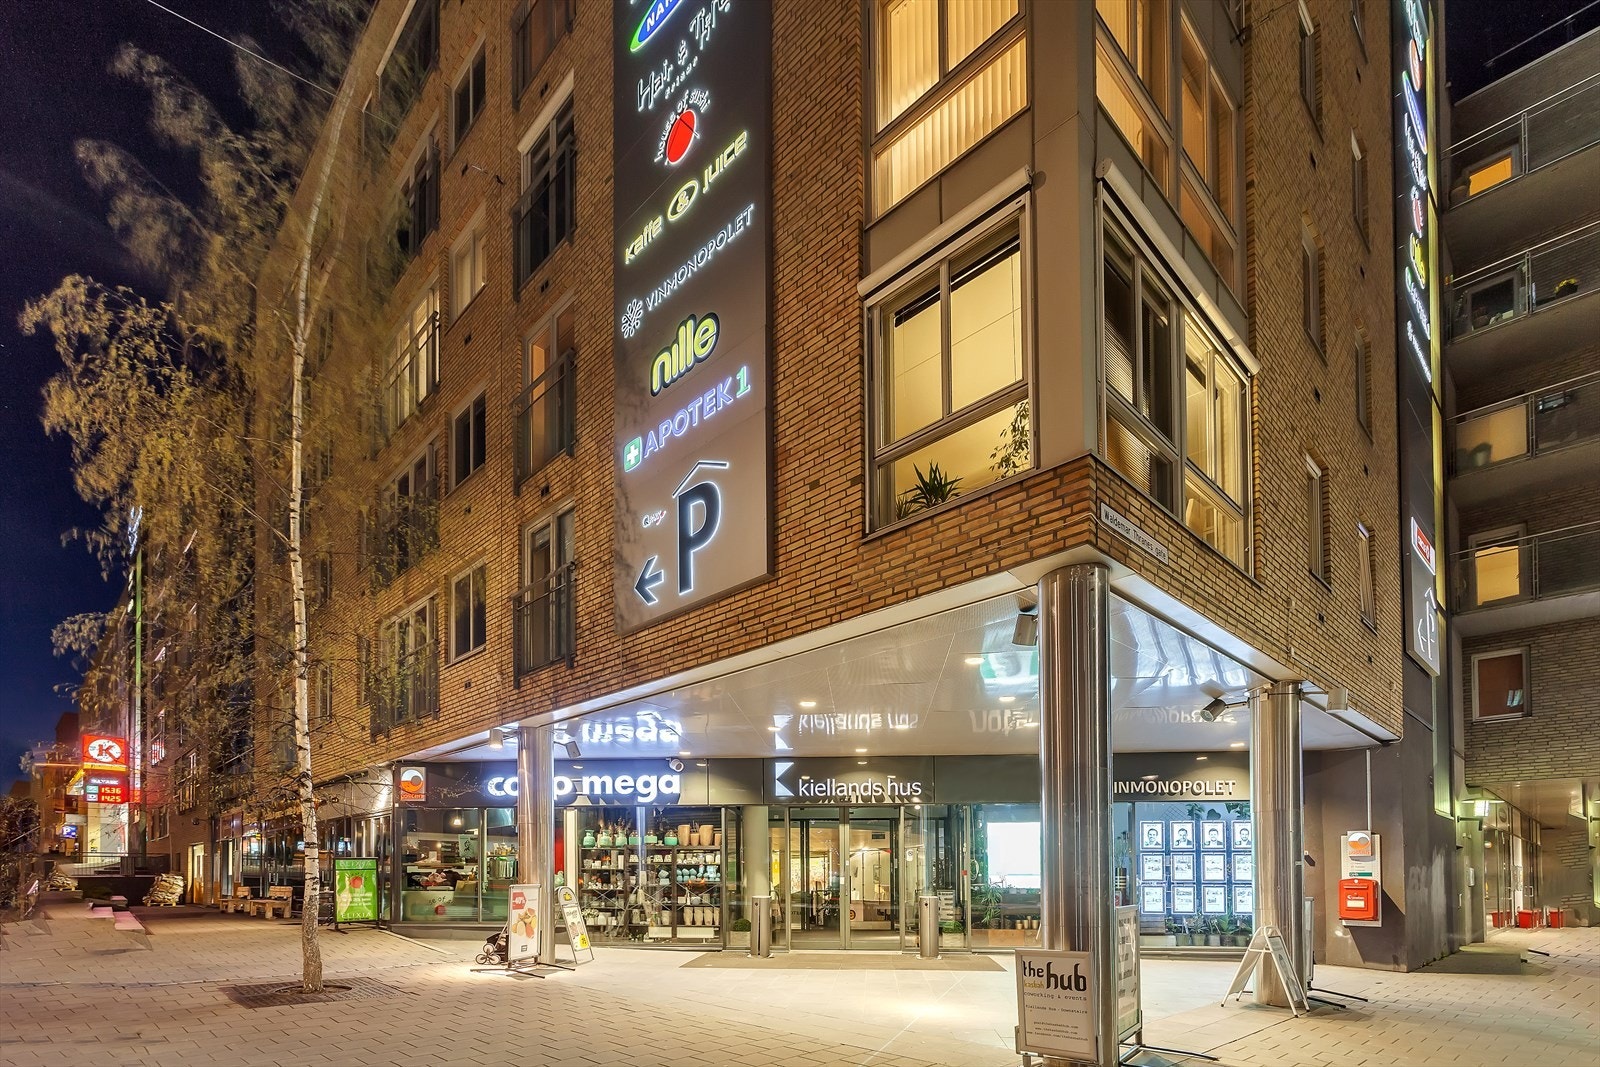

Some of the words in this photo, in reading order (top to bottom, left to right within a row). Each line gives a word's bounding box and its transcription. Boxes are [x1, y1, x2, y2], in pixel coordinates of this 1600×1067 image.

[637, 59, 674, 112] Hair
[677, 89, 690, 113] of
[677, 190, 690, 213] &
[645, 203, 755, 311] VINMONOPOLET
[651, 314, 719, 395] nille
[643, 376, 733, 458] APOTEK
[736, 365, 751, 398] 1
[1104, 509, 1131, 535] Waldemar
[677, 481, 722, 596] P
[97, 744, 119, 762] K
[487, 775, 573, 801] cop
[582, 773, 681, 803] mega
[798, 778, 883, 797] kiellands
[887, 778, 922, 797] hus
[1113, 779, 1236, 796] INMONOPOLET
[1022, 960, 1045, 978] the
[1046, 961, 1087, 992] hub
[1023, 991, 1055, 1000] coworking
